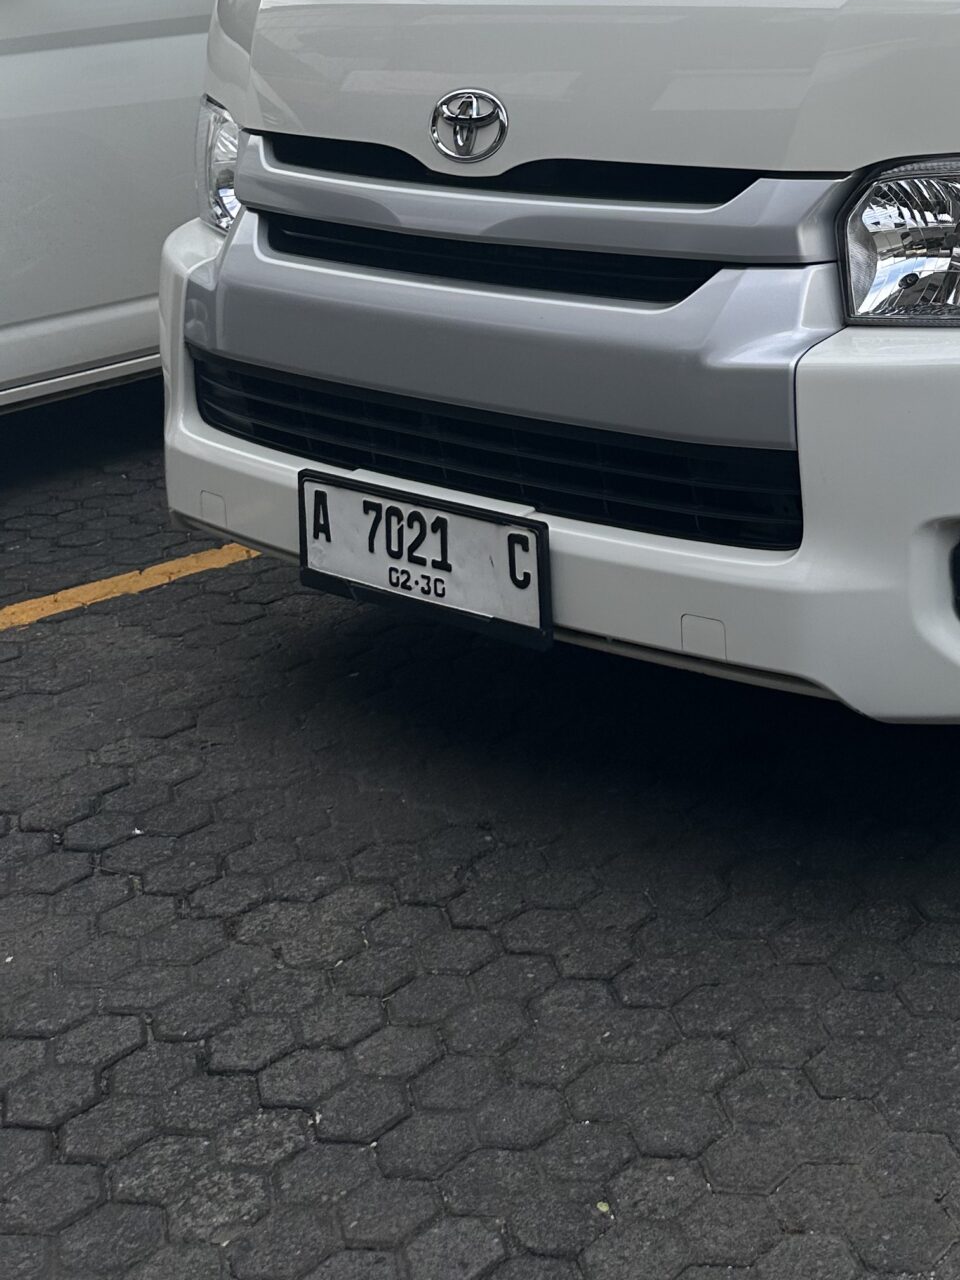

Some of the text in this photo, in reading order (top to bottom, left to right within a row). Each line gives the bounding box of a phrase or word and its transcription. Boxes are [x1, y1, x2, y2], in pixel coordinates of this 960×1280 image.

[313, 490, 531, 590] A 7021 C
